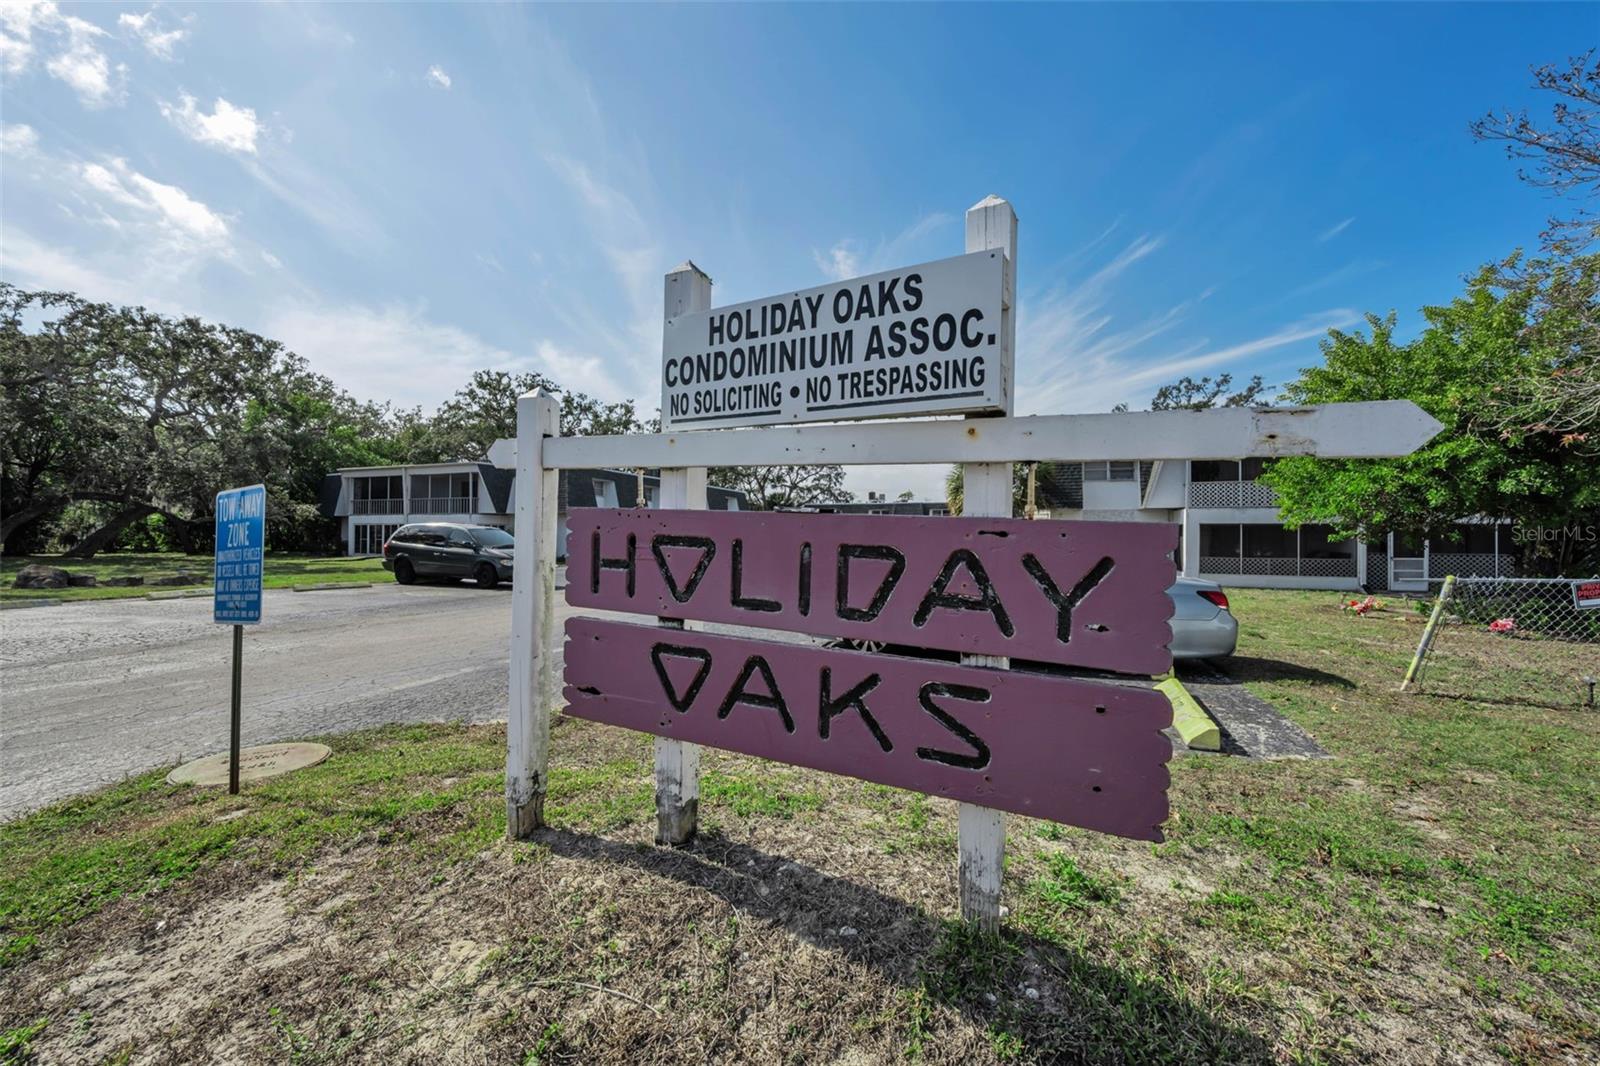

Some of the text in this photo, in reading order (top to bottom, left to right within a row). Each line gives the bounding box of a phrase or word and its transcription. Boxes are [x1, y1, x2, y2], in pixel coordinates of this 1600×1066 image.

[708, 273, 923, 346] HOLIDAY OAKS
[665, 308, 996, 387] CONDOMINIUM ASSOC.
[806, 356, 985, 403] NO TRESPASSING
[670, 381, 781, 416] NO SOLICITING
[227, 521, 250, 547] ZONE
[591, 530, 1115, 644] HOLIDAY
[651, 642, 992, 770] OAKS
